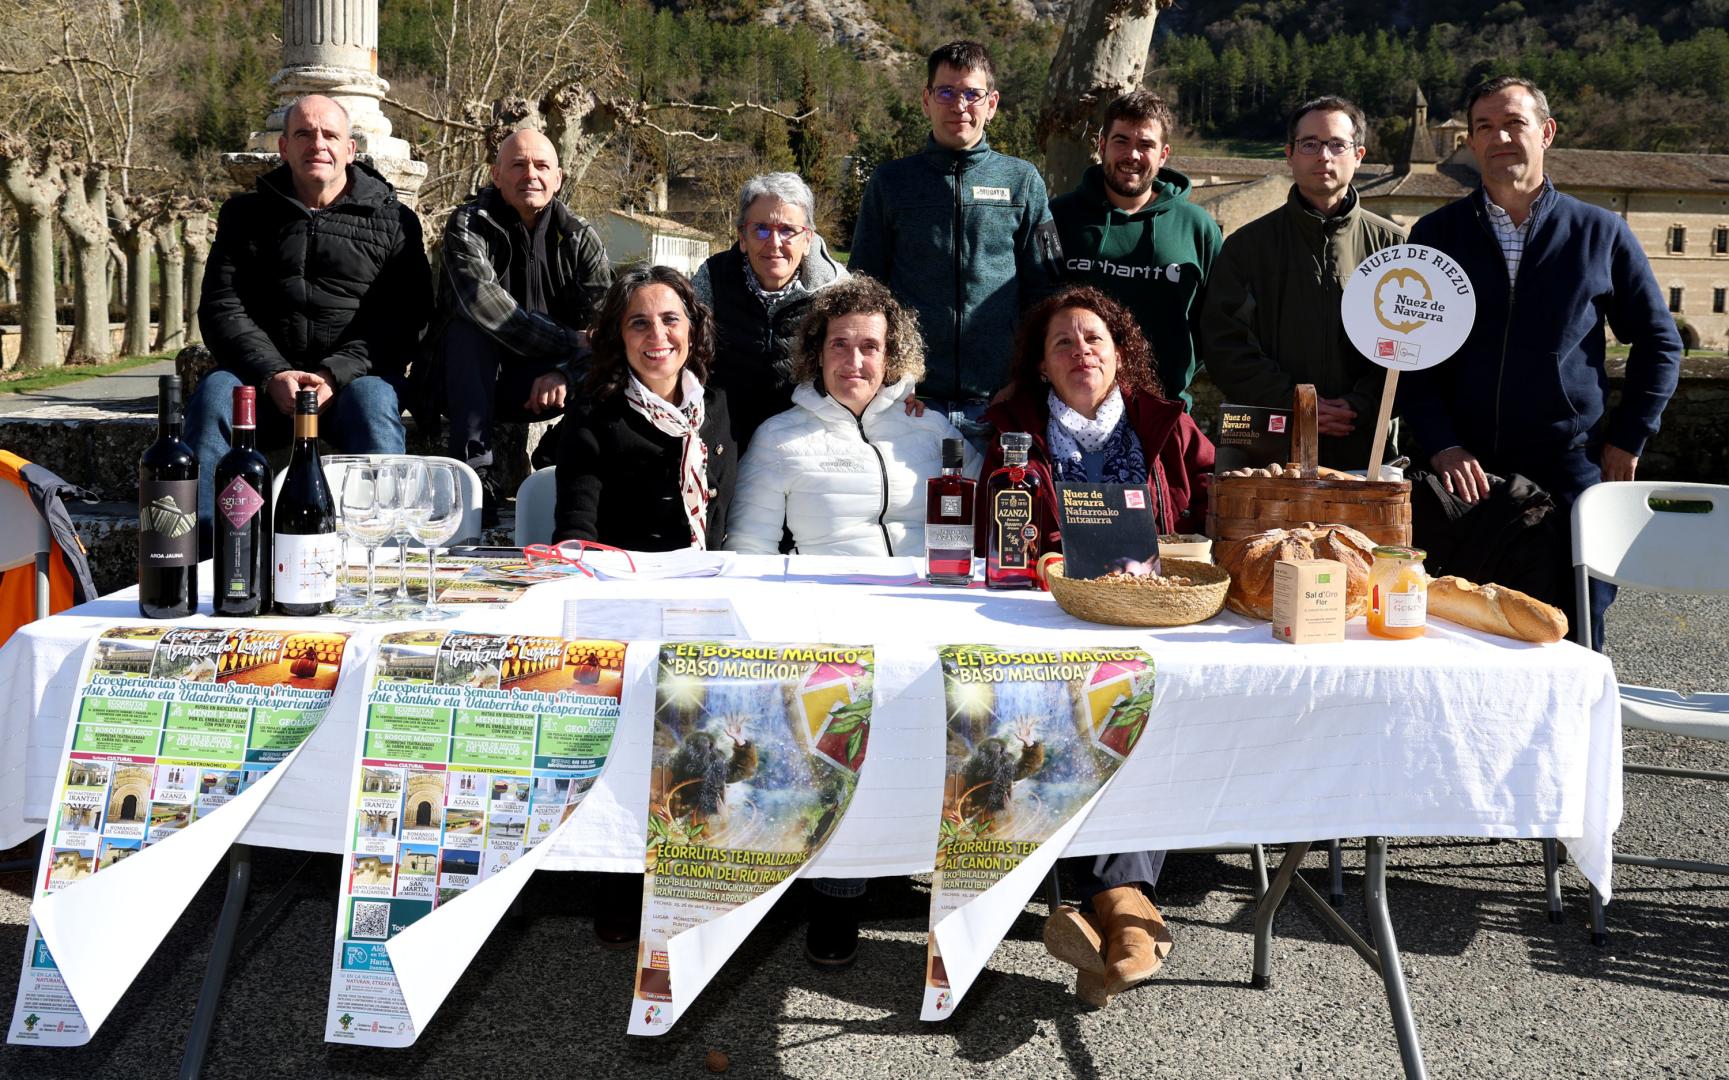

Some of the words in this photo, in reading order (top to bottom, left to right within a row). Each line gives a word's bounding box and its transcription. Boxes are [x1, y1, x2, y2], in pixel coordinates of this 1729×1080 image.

[1066, 258, 1163, 280] carhartt
[1359, 248, 1401, 277] NUEZ
[1407, 247, 1429, 261] DE
[1432, 255, 1469, 296] RIEZU
[1396, 294, 1427, 309] Nuez
[1430, 301, 1445, 312] de
[1393, 305, 1444, 323] Navarra
[1222, 421, 1250, 429] Navarra
[1223, 413, 1240, 421] Nuez
[1063, 490, 1088, 498] Nuez
[1091, 491, 1103, 499] de
[1064, 498, 1105, 507] Navarra
[998, 509, 1028, 517] AZANZA
[1065, 507, 1119, 516] Nafarroako
[1066, 516, 1112, 524] Intxaurra
[167, 637, 233, 662] Irantzuko
[237, 637, 282, 656] Lurrak
[449, 642, 515, 668] Irantzuko
[518, 641, 563, 661] Lurrak
[703, 645, 778, 661] BOSQUE
[984, 651, 1057, 666] BOSQUE
[92, 673, 176, 691] Ecoexperiencias
[178, 678, 224, 693] Semana
[227, 681, 261, 695] Santa
[262, 687, 271, 699] y
[273, 684, 331, 699] Primavera
[377, 680, 461, 697] Ecoexperiencias
[464, 685, 509, 699] Semana
[512, 688, 545, 702] Santa
[548, 694, 556, 706] y
[558, 691, 617, 706] Primavera
[82, 684, 105, 697] Aste
[107, 685, 155, 699] Santuko
[158, 689, 175, 700] eta
[179, 688, 243, 705] Udaberriko
[368, 690, 392, 703] Aste
[394, 691, 440, 706] Santuko
[444, 696, 460, 707] eta
[464, 696, 529, 712] Udaberriko
[532, 702, 621, 718] ekoesperientziak
[657, 844, 727, 862] ECORRUTAS
[730, 850, 808, 866] TEATRALIZADAS
[947, 840, 1013, 855] ECORRUTAS
[944, 860, 958, 870] AL
[961, 854, 1001, 870] CAÑÓN
[656, 862, 671, 876] AL
[673, 861, 714, 879] CAÑÓN
[717, 866, 737, 881] DEL
[740, 867, 757, 882] RÍO
[943, 871, 988, 880] EKO-IBILALDI
[655, 877, 701, 888] EKO-IBILALDI
[703, 881, 743, 892] MITOLOGIKO
[942, 881, 973, 889] IRANTZU
[654, 888, 685, 897] IRANTZU
[687, 890, 720, 900] IBAIAREN
